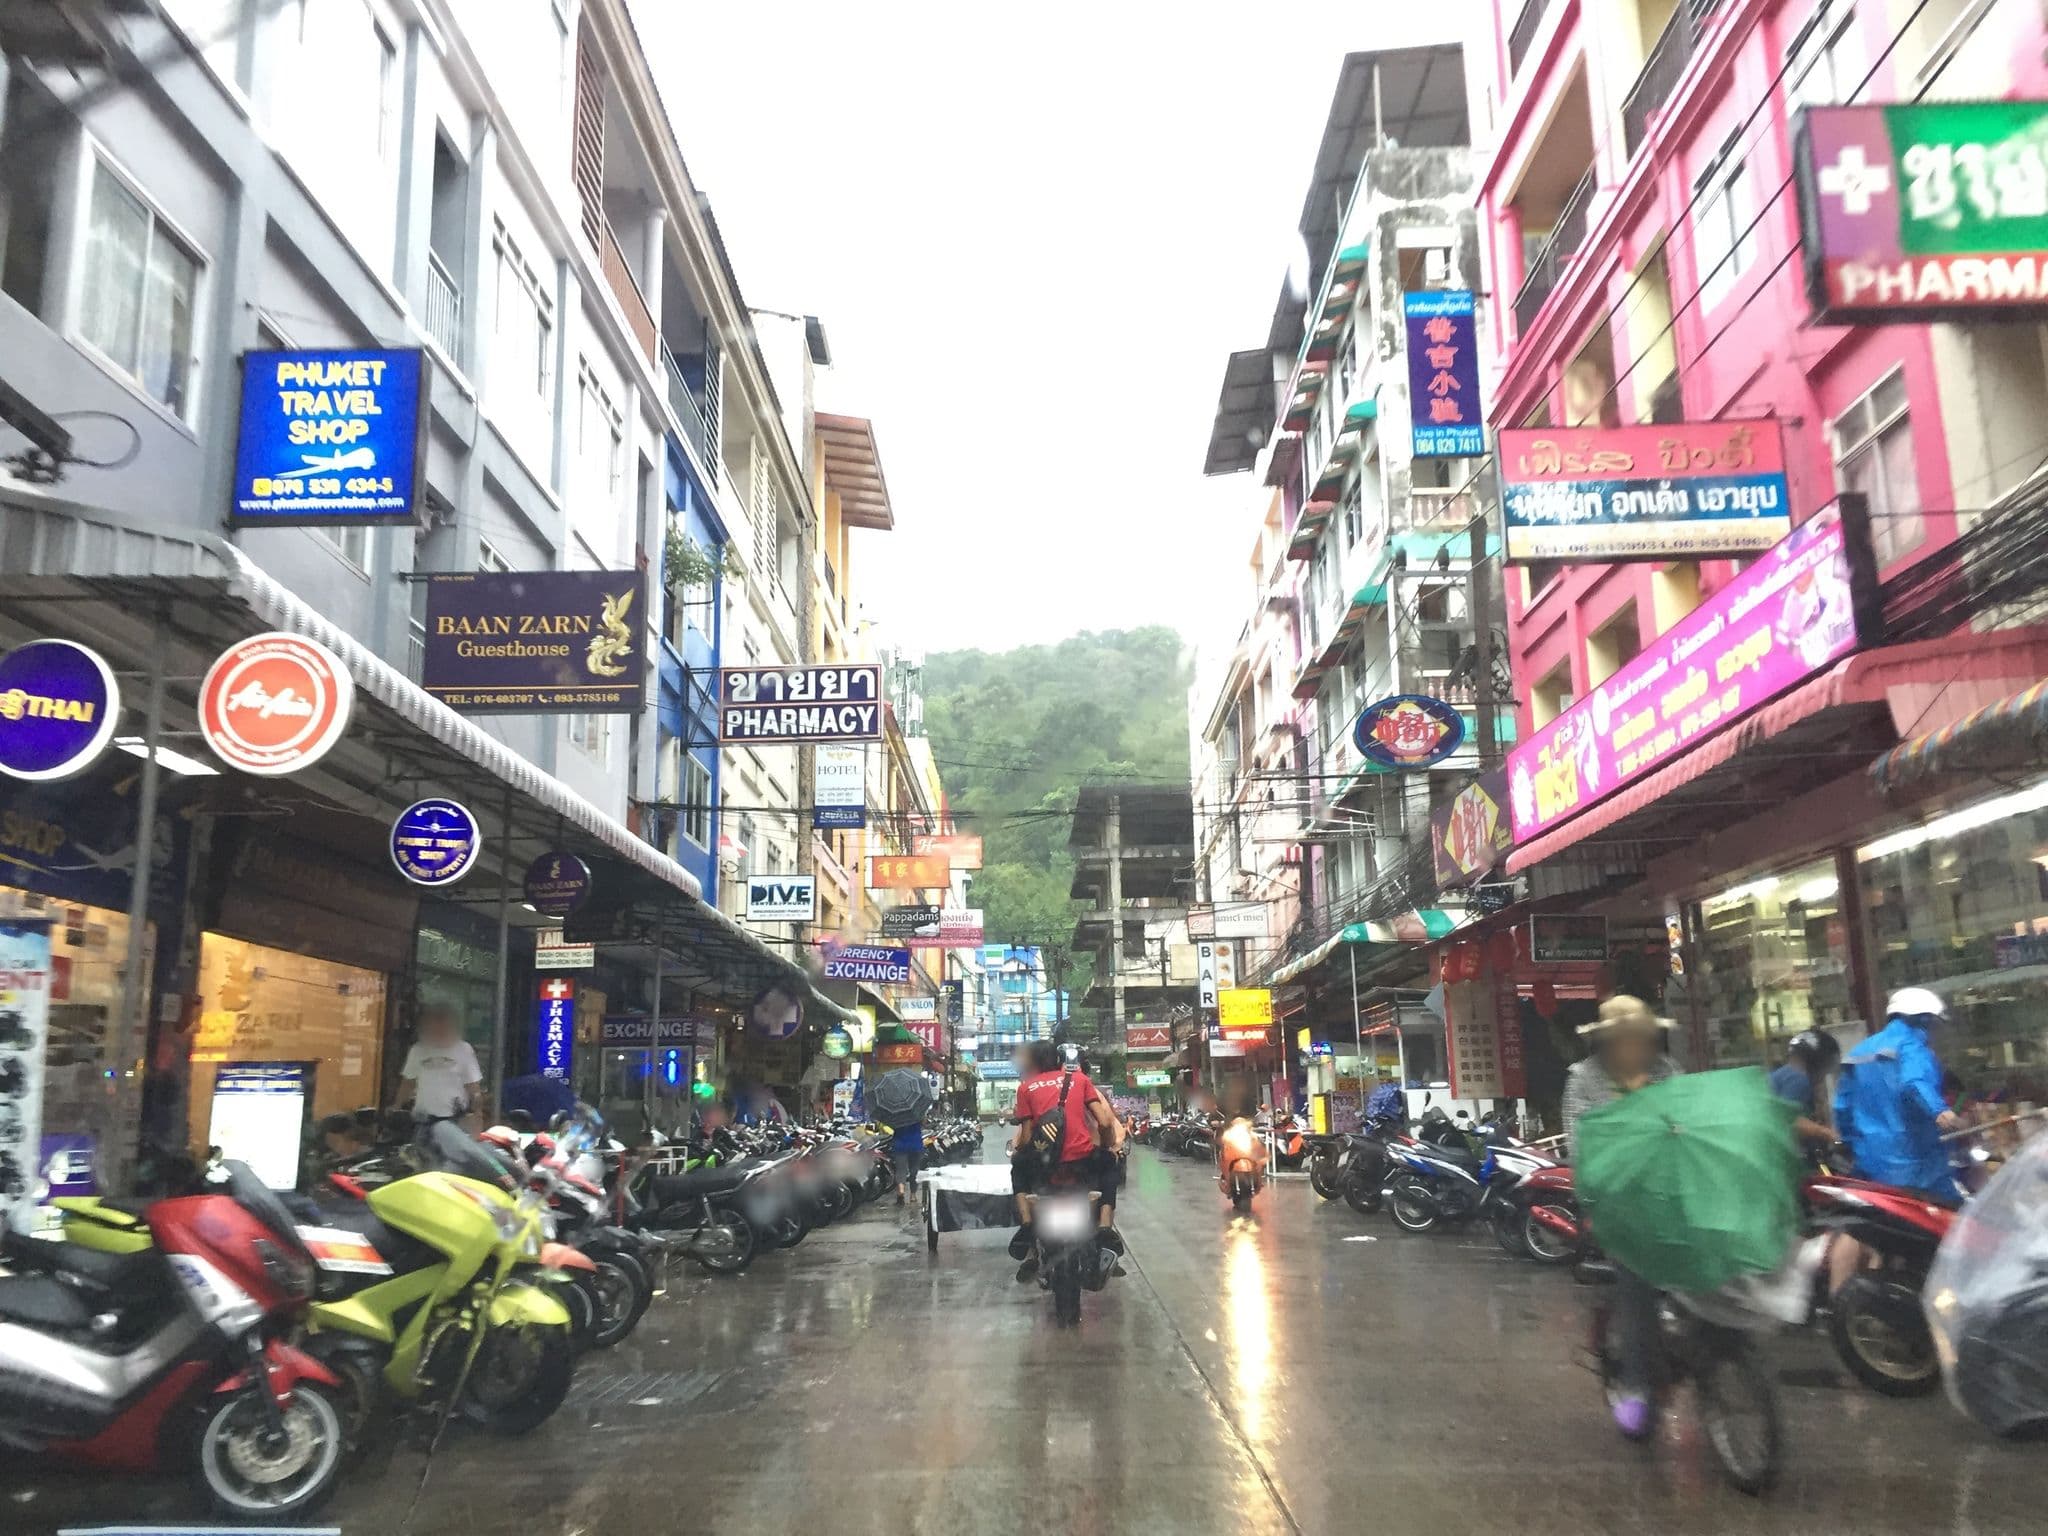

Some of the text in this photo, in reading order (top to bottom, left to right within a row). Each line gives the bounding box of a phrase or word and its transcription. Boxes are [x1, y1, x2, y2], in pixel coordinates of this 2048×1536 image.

[277, 361, 386, 386] PHUKET
[279, 390, 382, 415] TRAVEL
[288, 419, 369, 444] SHOP
[436, 615, 591, 635] BAAN ZARN
[457, 640, 570, 658] Guesthouse
[728, 669, 876, 702] ขายยา
[25, 694, 95, 723] THAI
[726, 705, 876, 736] PHARMACY
[818, 765, 862, 775] HOTEL
[751, 885, 811, 903] DIVE
[883, 910, 940, 924] Pappadams
[832, 948, 893, 961] URRENCY
[824, 962, 909, 981] EXCHANGE
[1201, 945, 1214, 1004] BAR
[546, 1000, 564, 1067] PHARMACY
[1028, 1076, 1066, 1092] Staf
